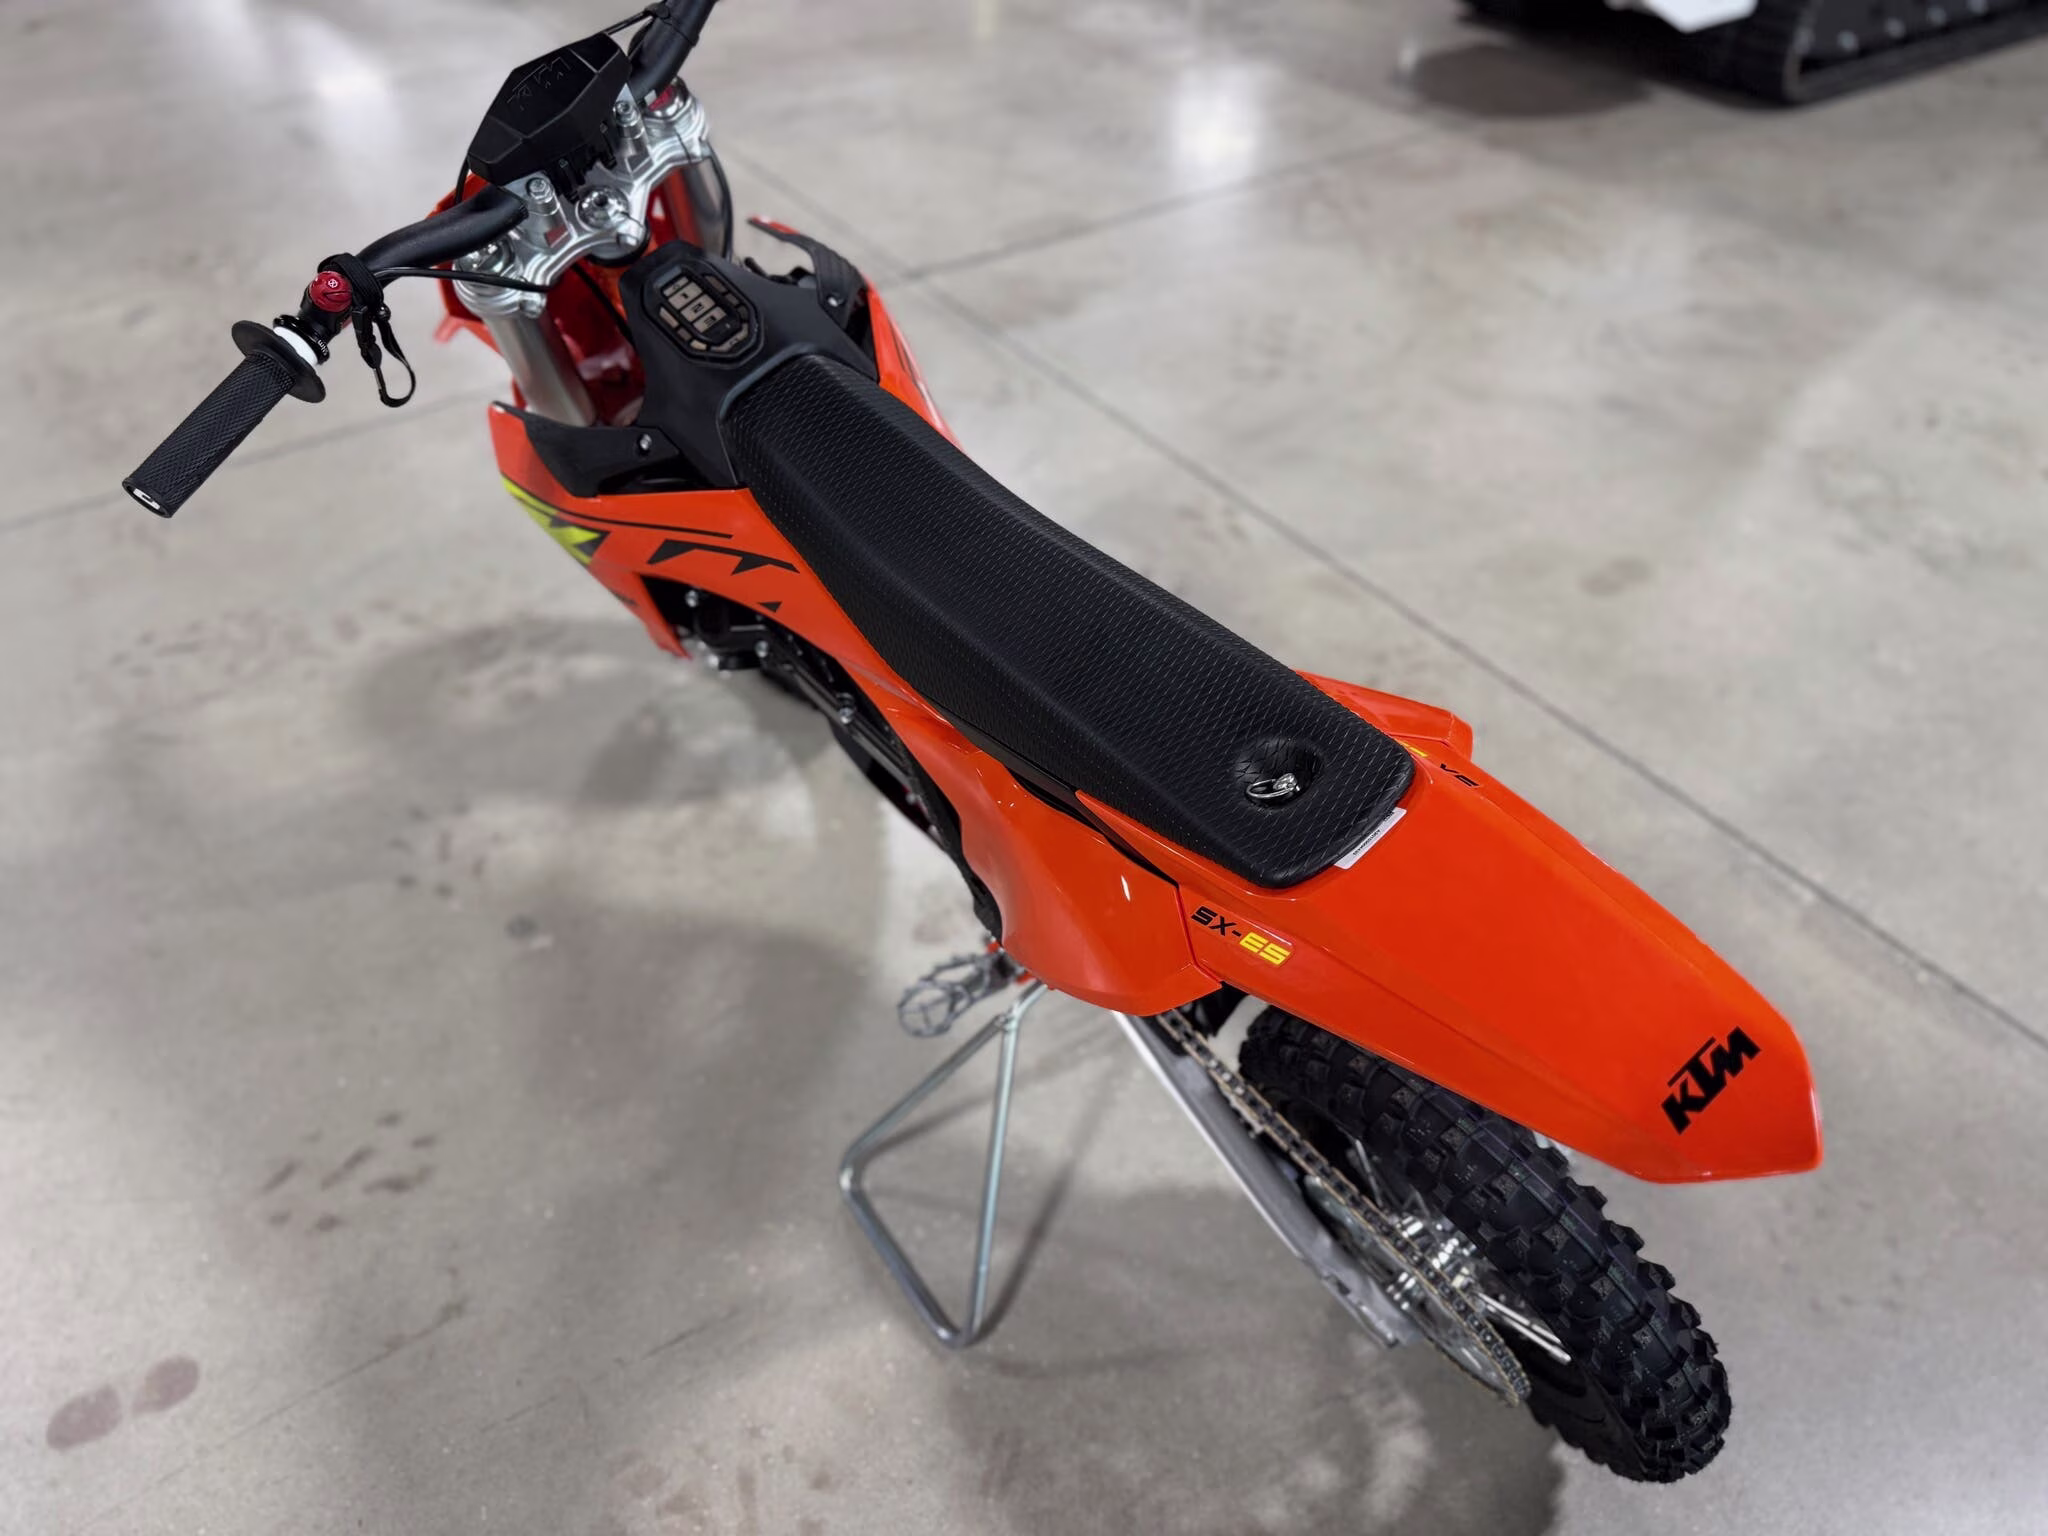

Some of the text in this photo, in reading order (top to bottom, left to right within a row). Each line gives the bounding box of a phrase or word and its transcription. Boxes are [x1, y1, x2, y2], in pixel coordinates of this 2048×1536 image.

[506, 56, 571, 112] KTM
[1191, 905, 1291, 965] SX-ES
[1661, 1026, 1762, 1135] KTM
